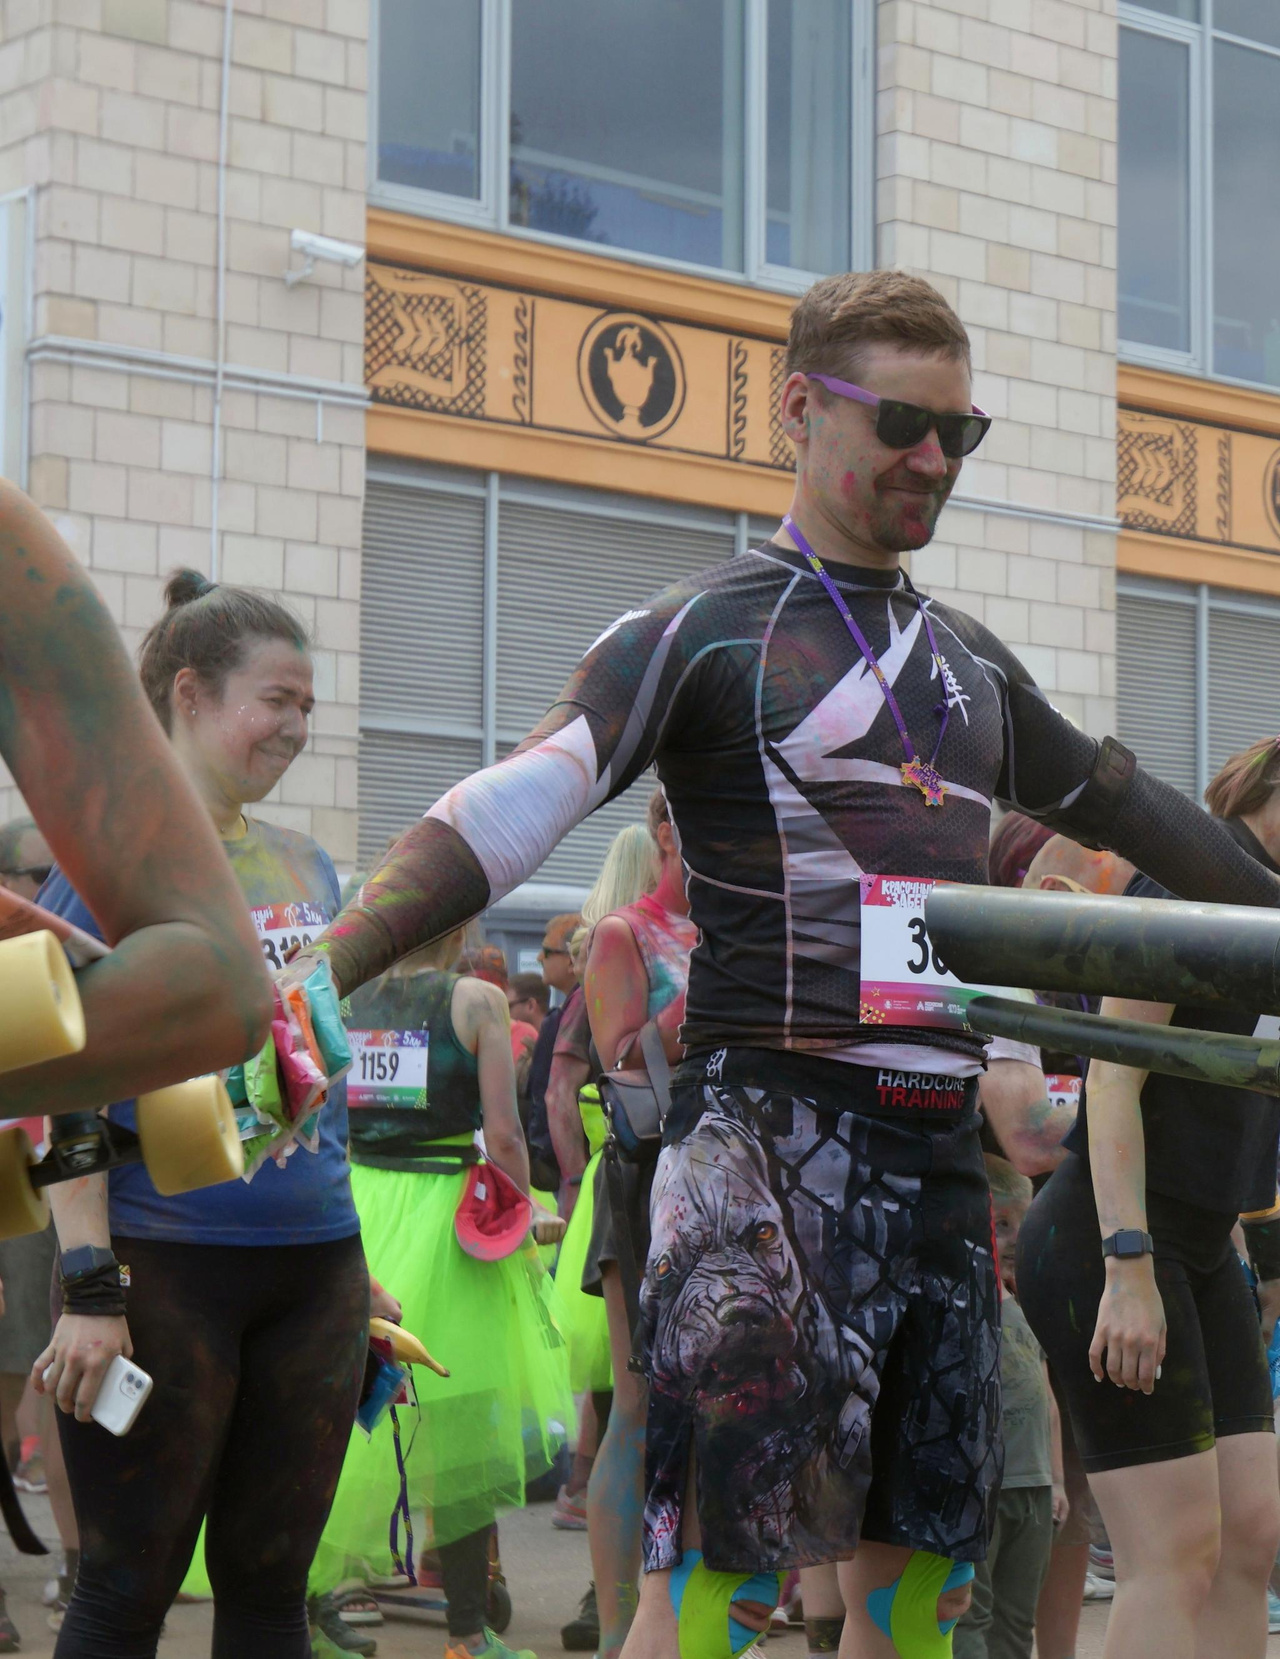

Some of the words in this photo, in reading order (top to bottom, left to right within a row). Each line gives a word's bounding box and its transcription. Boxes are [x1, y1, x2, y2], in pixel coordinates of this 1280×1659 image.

[359, 1050, 400, 1082] 1159
[877, 1069, 965, 1092] HARDCORE
[876, 1085, 966, 1110] TRAINING
